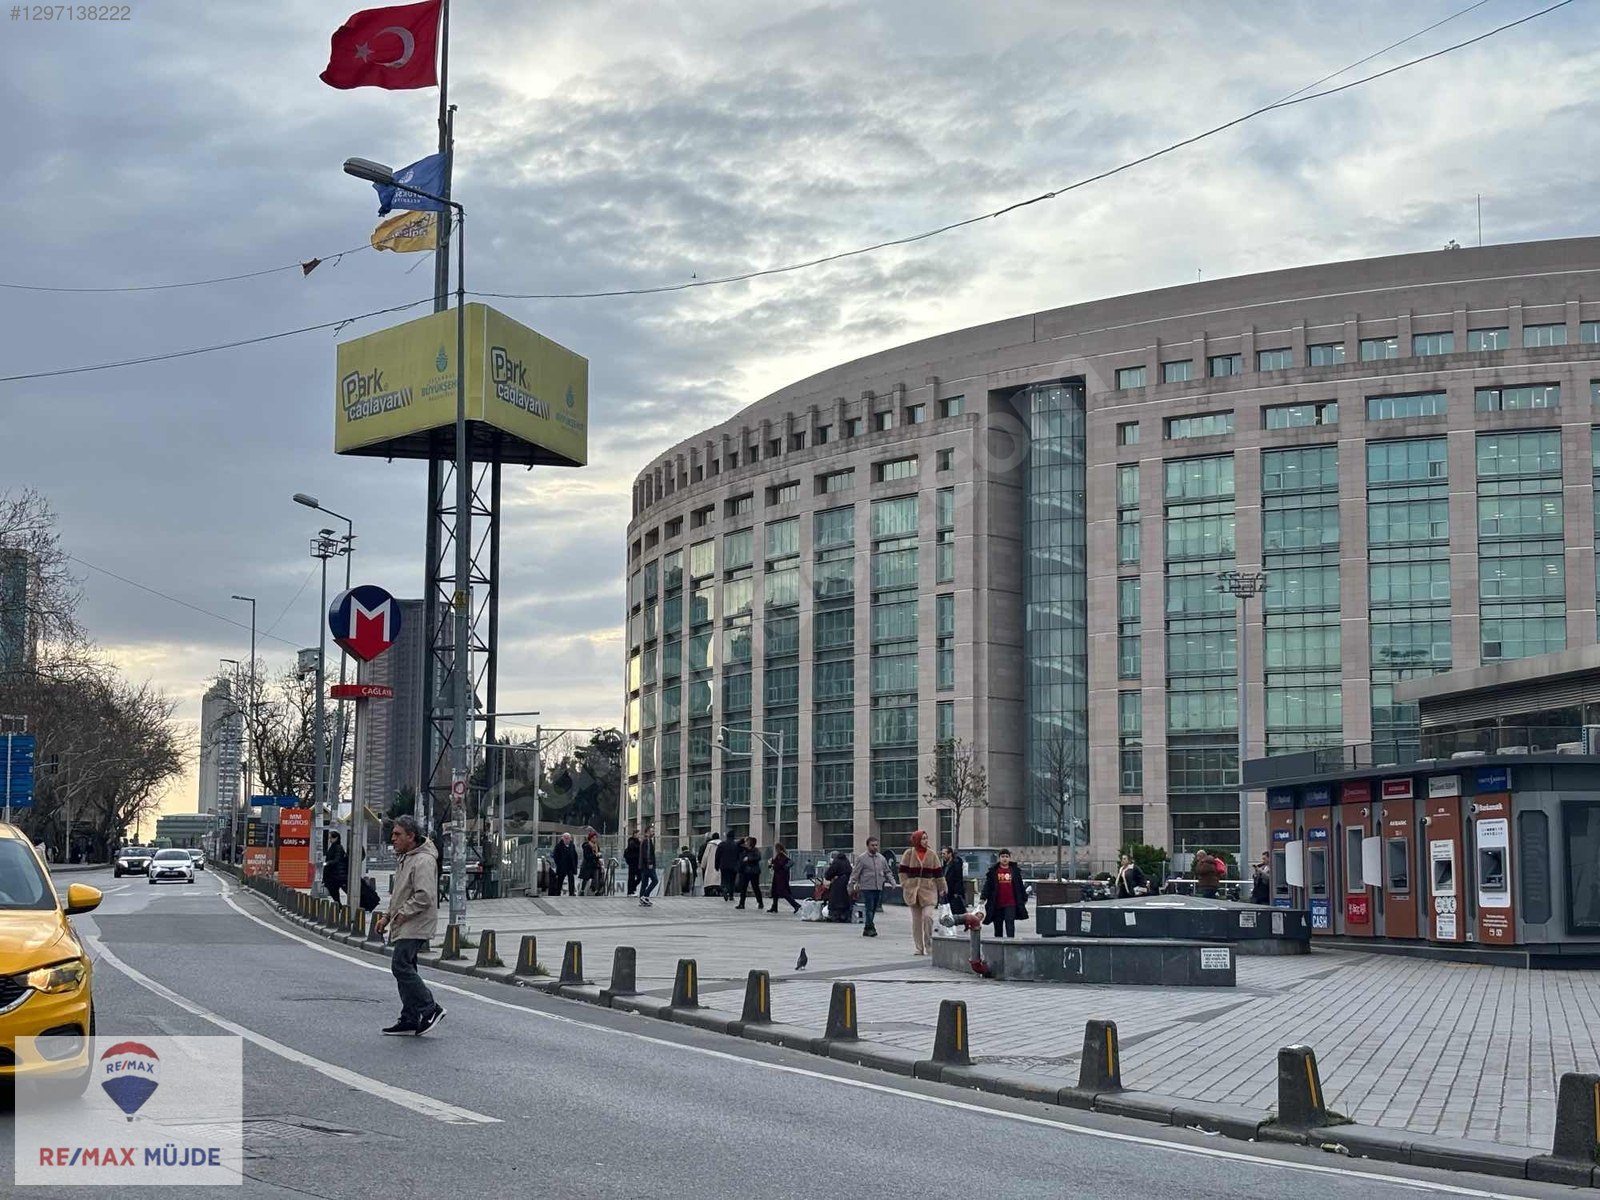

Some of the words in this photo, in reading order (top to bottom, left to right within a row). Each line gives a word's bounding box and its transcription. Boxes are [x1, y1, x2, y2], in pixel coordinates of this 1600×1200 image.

[342, 368, 384, 410] Park
[491, 347, 527, 389] Park
[349, 594, 391, 643] M
[1312, 915, 1328, 928] CASH
